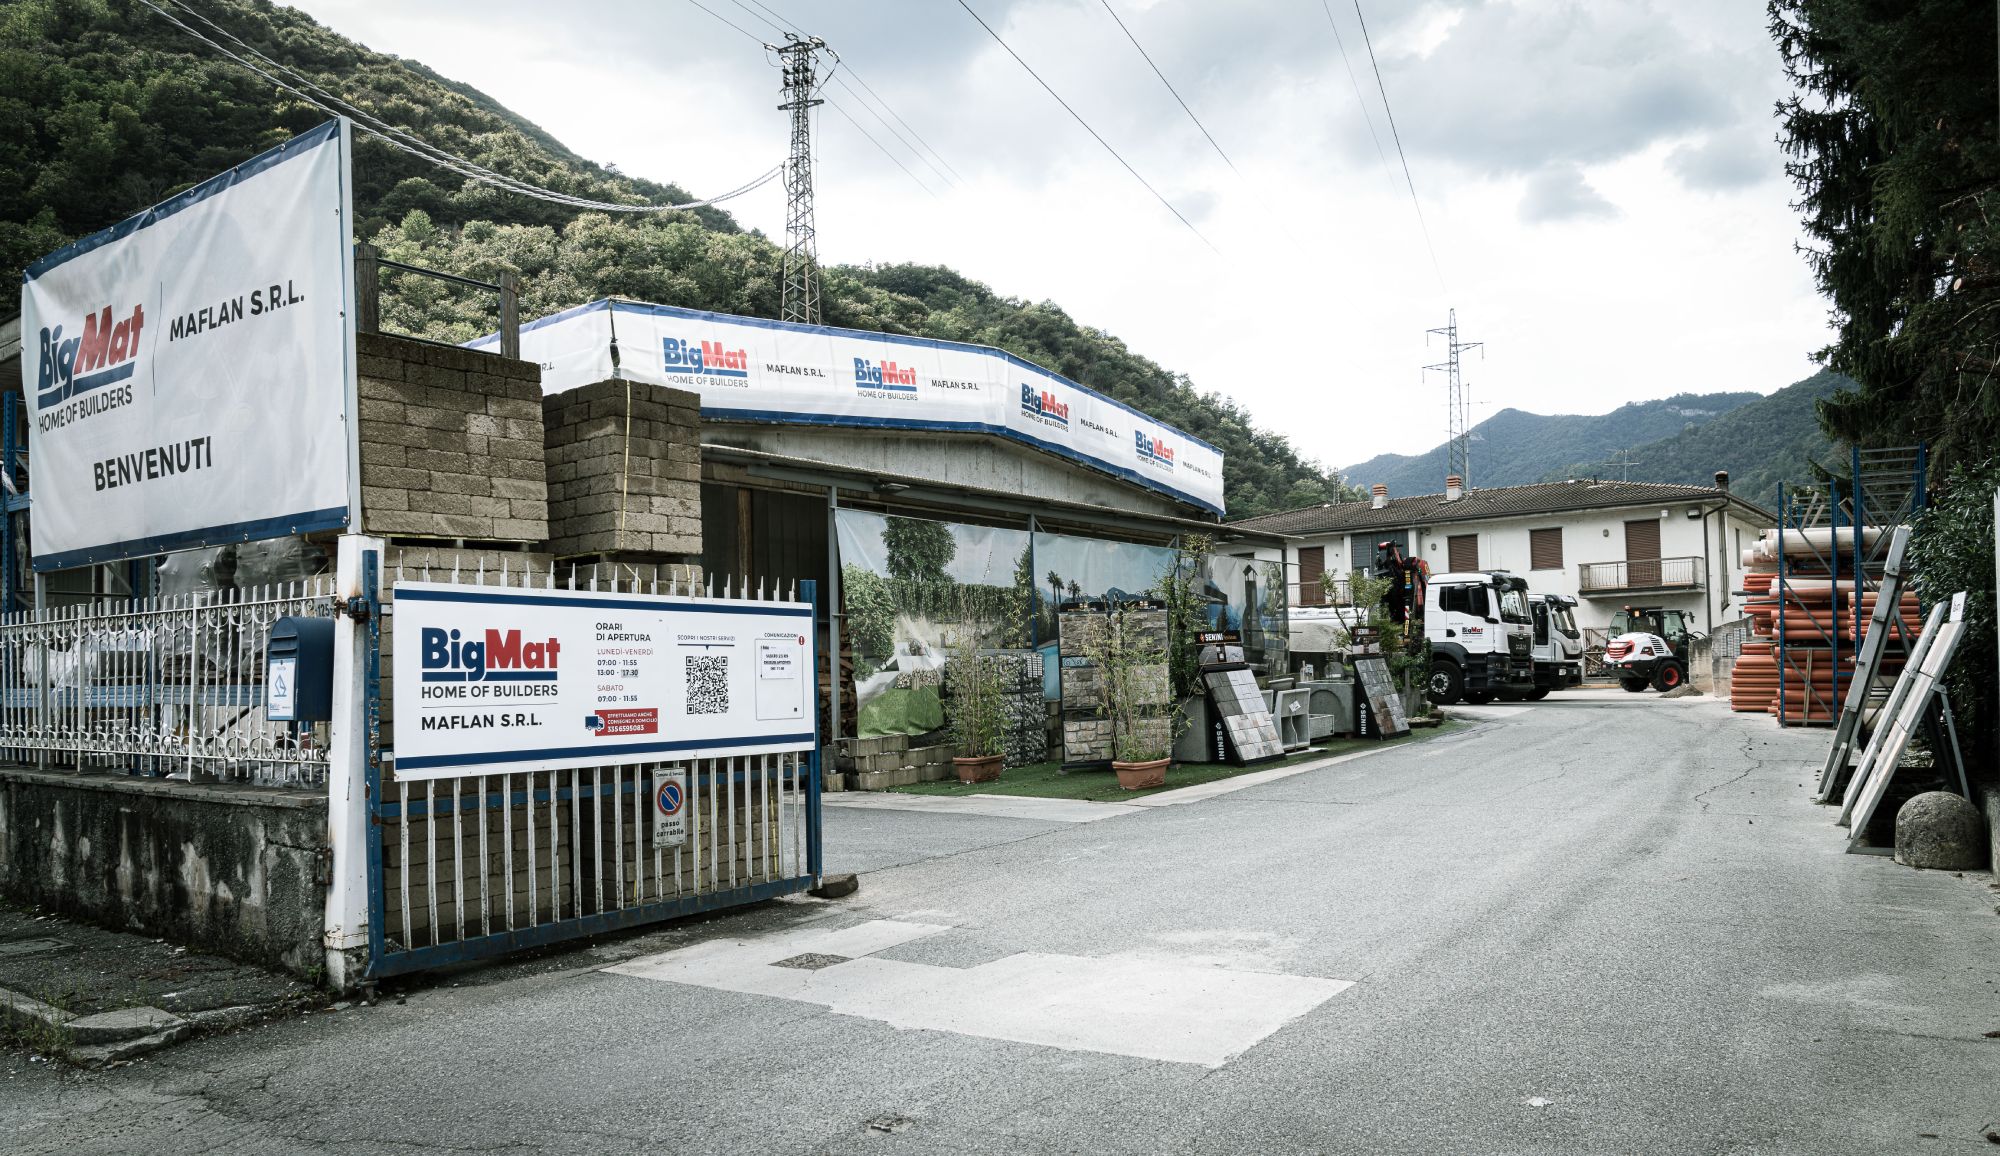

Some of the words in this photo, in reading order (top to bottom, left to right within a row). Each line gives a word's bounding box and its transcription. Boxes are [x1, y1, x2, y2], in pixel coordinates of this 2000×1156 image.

[170, 296, 243, 341] MAFLAN
[251, 280, 304, 315] S.R.L.
[38, 304, 144, 400] BigMat
[663, 337, 747, 374] BigMat
[766, 364, 801, 376] MAFLAN
[803, 367, 826, 378] S.R.L.
[854, 357, 917, 389] BigMat
[667, 375, 694, 385] HOME
[696, 376, 708, 385] OF
[709, 377, 749, 388] BUILDERS
[931, 379, 960, 389] MAFLAN
[960, 382, 980, 391] S.R.L.
[857, 390, 877, 399] HOME
[877, 391, 886, 399] OF
[887, 391, 919, 401] BUILDERS
[1021, 383, 1069, 419] BigMat
[38, 408, 65, 434] HOME
[66, 405, 77, 423] OF
[80, 384, 133, 419] BUILDERS
[1021, 410, 1036, 421] HOME
[1036, 416, 1044, 424] OF
[1044, 419, 1069, 432] BUILDERS
[1080, 418, 1104, 432] MAFLAN
[1105, 427, 1120, 438] S.R.L.
[1135, 430, 1174, 462] BigMat
[93, 436, 212, 491] BENVENUTI
[595, 622, 623, 631] ORARI
[596, 633, 605, 641] DI
[607, 633, 651, 642] APERTURA
[422, 627, 560, 681] BigMat
[421, 686, 466, 699] HOME
[470, 685, 490, 698] OF
[493, 684, 559, 697] BUILDERS
[596, 684, 624, 692] SABATO
[421, 714, 494, 730] MAFLAN
[500, 712, 543, 727] S.R.L.
[1216, 730, 1225, 760] SENINI
[656, 828, 684, 837] carrabile
[661, 820, 680, 828] passo
